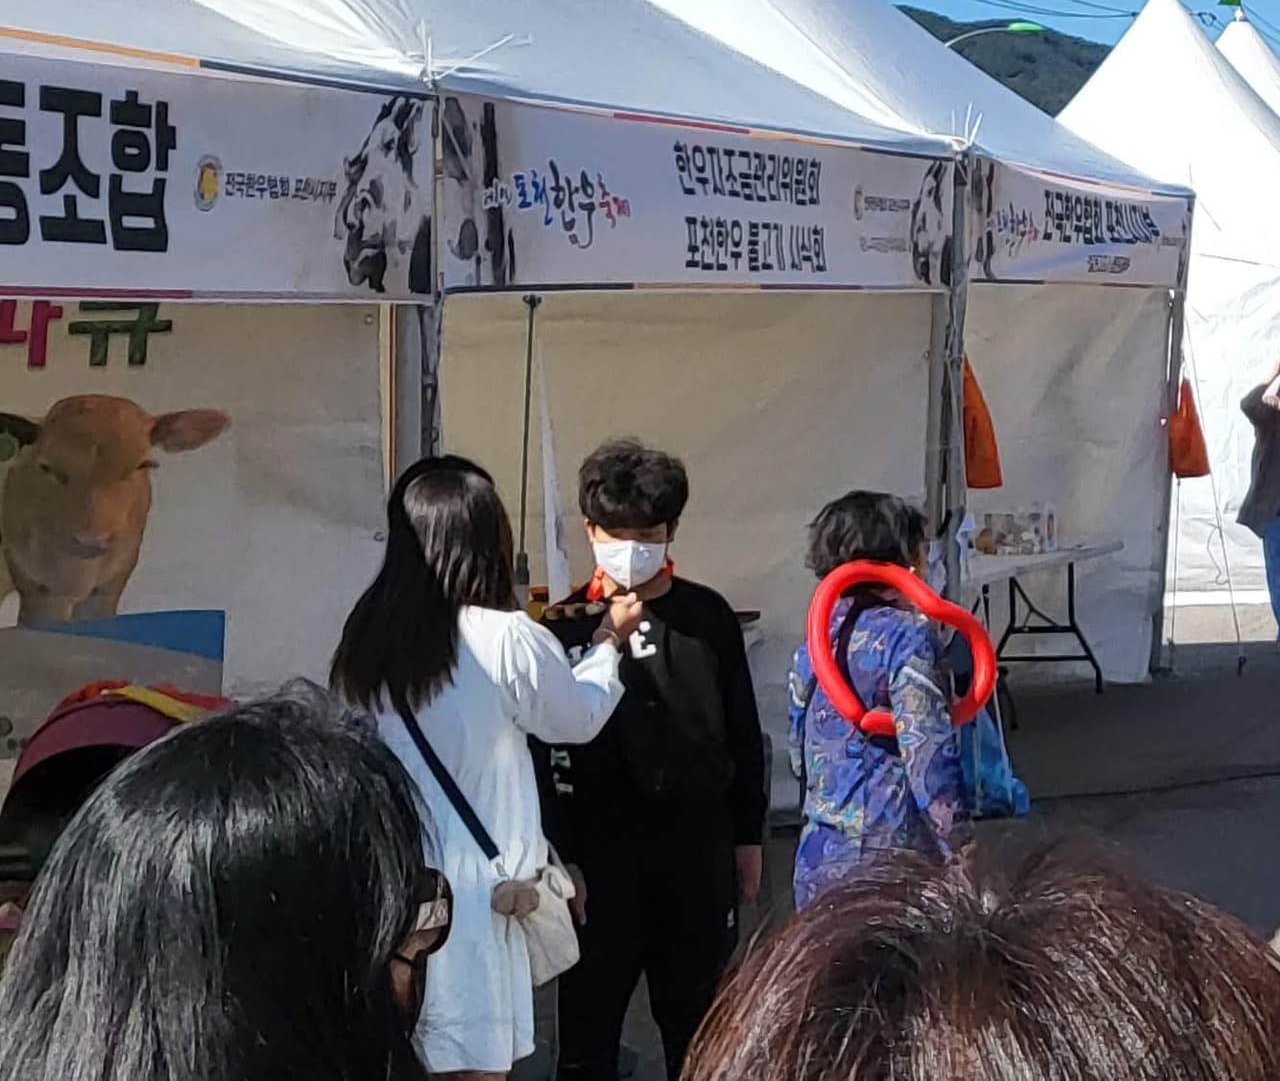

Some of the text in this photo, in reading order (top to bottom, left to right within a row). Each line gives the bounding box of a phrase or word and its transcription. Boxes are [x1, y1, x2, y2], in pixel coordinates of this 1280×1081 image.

[673, 140, 822, 206] 한우자조금관리위원회
[685, 215, 828, 273] 포천한우 불고기 시식회
